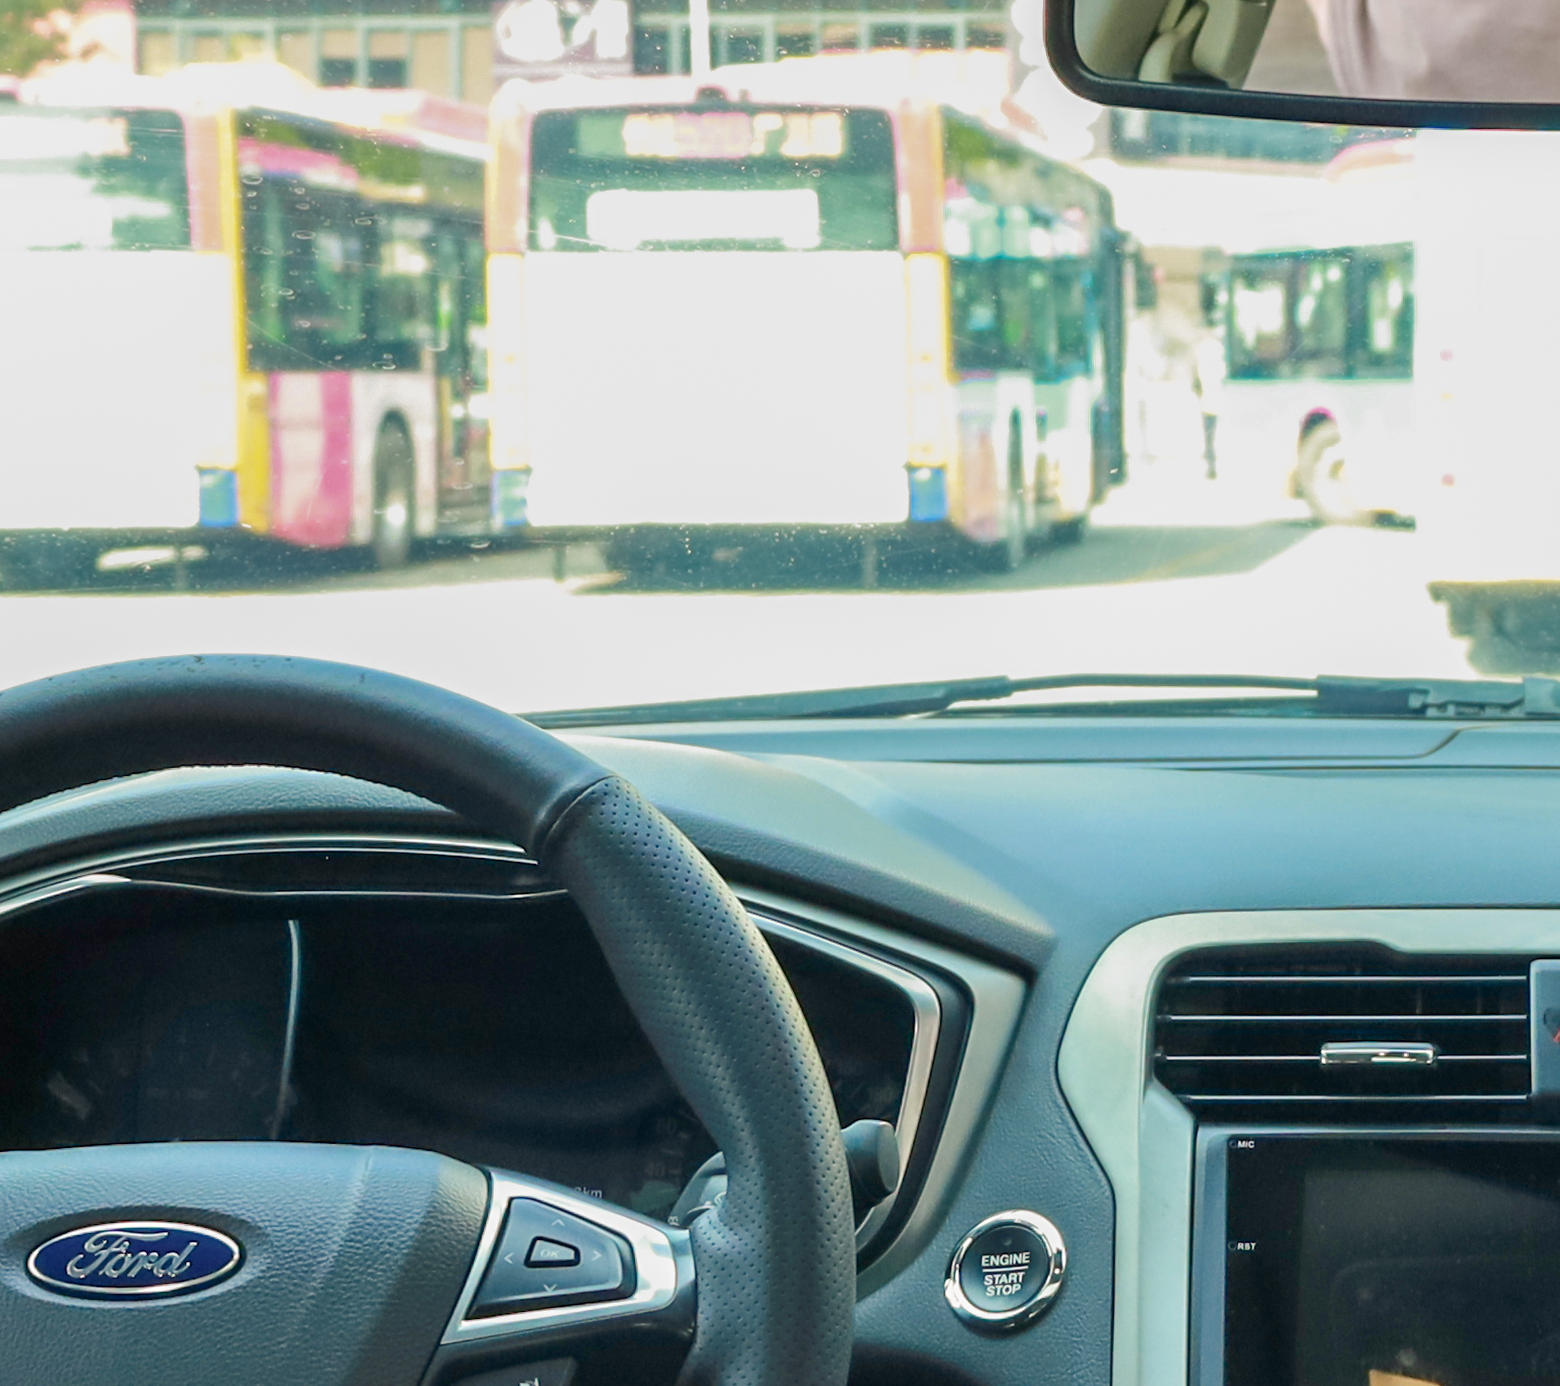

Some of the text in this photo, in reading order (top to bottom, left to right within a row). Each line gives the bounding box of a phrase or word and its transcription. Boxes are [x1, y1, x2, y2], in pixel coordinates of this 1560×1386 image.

[66, 1230, 199, 1280] Ford
[981, 1251, 1031, 1267] ENGINE
[983, 1271, 1026, 1286] START
[985, 1283, 1022, 1297] STOP
